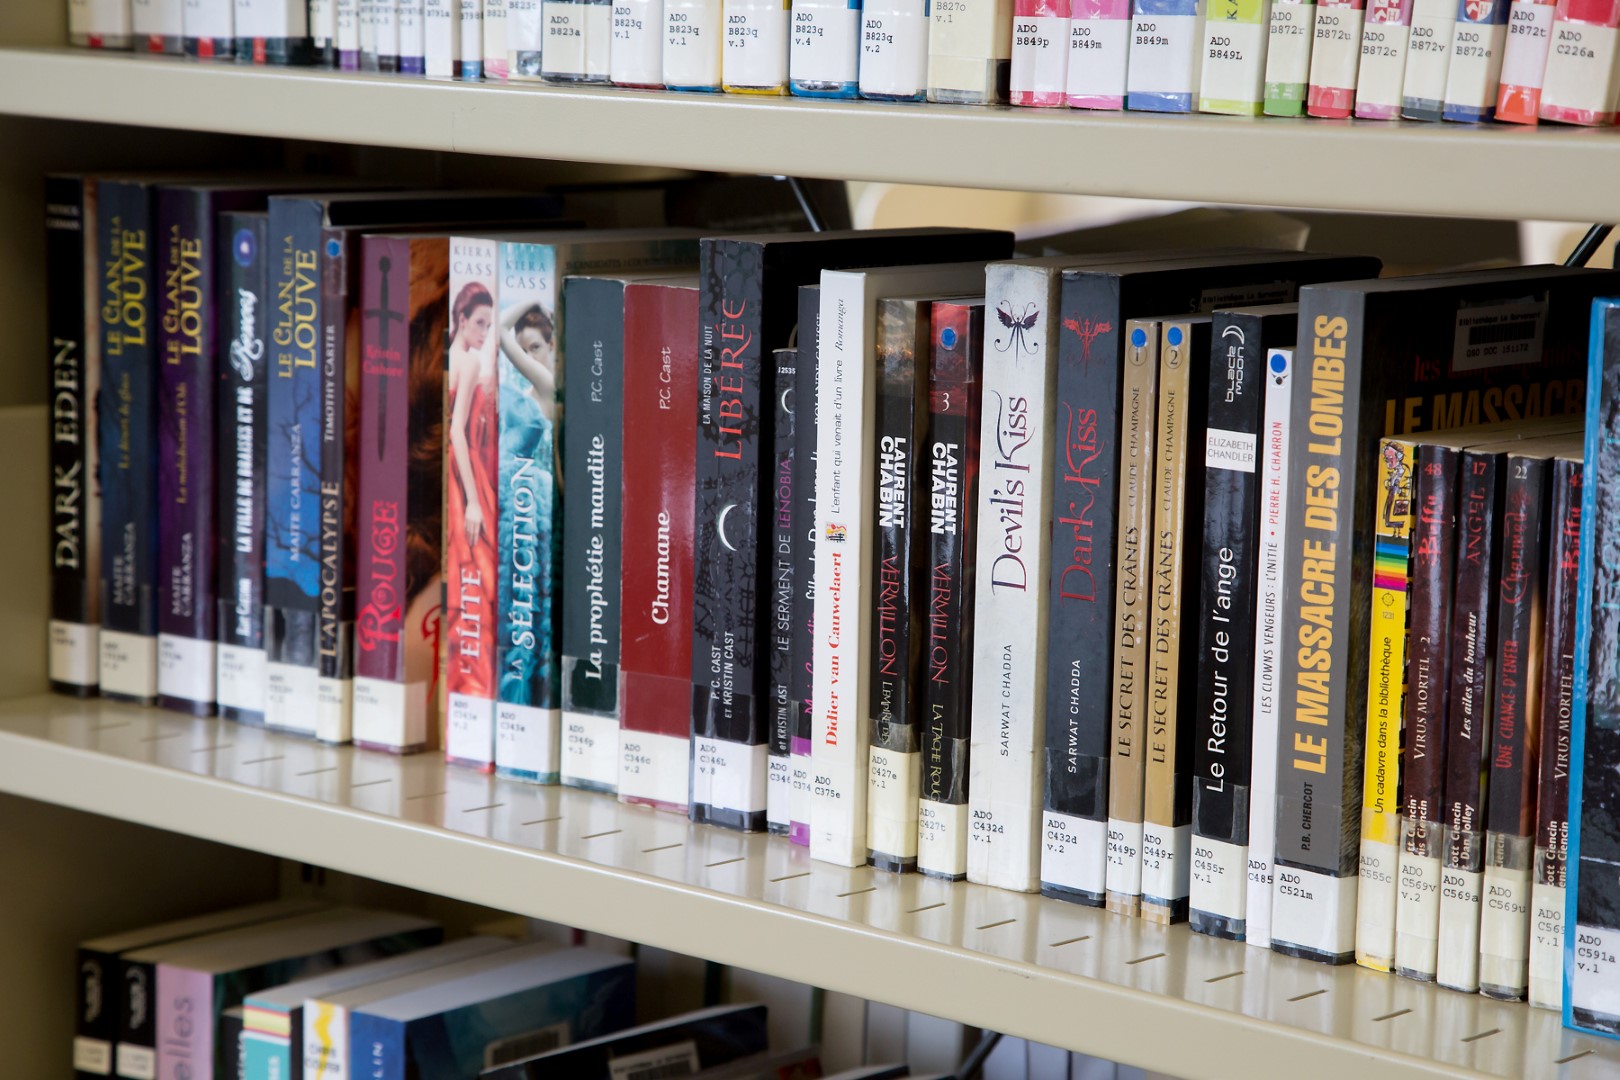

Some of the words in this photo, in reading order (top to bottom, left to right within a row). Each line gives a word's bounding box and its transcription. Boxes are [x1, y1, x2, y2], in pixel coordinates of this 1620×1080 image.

[551, 16, 569, 24] ADO
[796, 13, 813, 21] ADO
[866, 20, 882, 28] ADO
[1136, 24, 1156, 32] ADO
[1512, 11, 1535, 21] ADO
[550, 28, 580, 37] B823a
[669, 26, 700, 36] B823q
[669, 37, 686, 45] v.1
[796, 25, 823, 36] B823q
[866, 32, 893, 43] B823q
[1016, 25, 1038, 33] ADO
[1136, 36, 1169, 45] B849m
[1363, 33, 1385, 42] ADO
[1511, 25, 1547, 37] B872t
[1559, 31, 1582, 41] ADO
[796, 37, 811, 46] v.4
[865, 45, 880, 53] v.2
[1016, 37, 1050, 47] B849p
[1210, 37, 1231, 46] ADO
[1362, 46, 1397, 57] B872c
[1557, 45, 1595, 58] C226a
[1209, 50, 1243, 61] B849L
[452, 261, 492, 277] CASS
[122, 230, 146, 346] LOUVE
[504, 275, 546, 291] CASS
[180, 238, 202, 356] LOUVE
[294, 249, 317, 370] LOUVE
[323, 324, 335, 376] CARTER
[590, 340, 603, 377] Cast
[1169, 349, 1179, 366] 2
[659, 346, 671, 383] Cast
[833, 360, 843, 383] livre
[53, 337, 80, 445] EDEN
[714, 297, 752, 462] LIBÉRÉE
[1308, 314, 1348, 456] LOMBES
[590, 381, 603, 403] P.C.
[659, 387, 671, 410] P.C.
[834, 386, 843, 410] d'un
[323, 378, 336, 443] TIMOTHY
[1129, 386, 1141, 458] CHAMPAGNE
[834, 413, 843, 447] venait
[990, 390, 1036, 474] Kiss
[1164, 389, 1176, 462] CHAMPAGNE
[1061, 400, 1104, 489] Kiss
[1207, 448, 1254, 463] CHANDLER
[1208, 436, 1254, 452] ELIZABETH
[833, 450, 844, 468] qui
[1423, 461, 1442, 476] 48
[1472, 461, 1488, 476] 17
[588, 433, 604, 529] maudite
[878, 435, 895, 528] CHABIN
[894, 437, 907, 529] LAURENT
[1514, 464, 1528, 479] 22
[779, 458, 793, 529] LENOBIA
[830, 470, 843, 514] L'enfant
[930, 441, 947, 535] CHABIN
[946, 443, 960, 537] LAURENT
[1128, 463, 1137, 507] CLAUDE
[1163, 466, 1174, 512] CLAUDE
[1304, 465, 1341, 532] DES
[55, 459, 81, 569] DARK
[1466, 486, 1486, 566] ANGEL
[779, 534, 792, 555] DE
[989, 479, 1027, 597] Devil's
[1057, 488, 1097, 603] Dark
[508, 455, 536, 650] SÉLECTION
[1500, 511, 1532, 605] Charmed
[319, 480, 340, 660] L'APOCALYPSE
[357, 500, 402, 652] ROUGE
[651, 509, 670, 626] Chamane
[1121, 525, 1139, 607] CRÂNES
[1155, 530, 1174, 612] CRÂNES
[586, 533, 608, 646] prophétie
[778, 559, 791, 631] SERMENT
[1211, 547, 1237, 623] l'ange
[828, 553, 843, 651] Cauwelaert
[458, 567, 482, 675] L'ÉLITE
[879, 554, 902, 676] VERMILLON
[930, 563, 951, 685] VERMILLON
[778, 635, 790, 651] LE
[1120, 613, 1136, 649] DES
[1154, 616, 1170, 654] DES
[1295, 538, 1337, 727] MASSACRE
[1464, 611, 1478, 664] bonheur
[725, 631, 735, 660] CAST
[1211, 631, 1230, 663] de
[511, 657, 523, 680] LA
[585, 649, 603, 681] La
[830, 655, 841, 687] van
[1001, 644, 1012, 698] CHADDA
[1379, 636, 1393, 706] bibliothèque
[1502, 639, 1519, 688] D'ENFER
[723, 663, 735, 706] KRISTIN
[1069, 659, 1081, 714] CHADDA
[1463, 668, 1475, 685] du
[778, 684, 788, 705] CAST
[1118, 655, 1134, 731] SECRET
[1152, 660, 1168, 736] SECRET
[1462, 686, 1473, 716] ailes
[724, 709, 732, 719] ET
[778, 707, 788, 739] KRISTIN
[826, 691, 839, 747] Didier
[932, 703, 944, 720] LA
[1207, 670, 1229, 754] Retour
[1379, 707, 1388, 719] la
[1499, 695, 1517, 740] CHANCE
[1000, 703, 1010, 757] SARWAT
[1378, 721, 1388, 749] dans
[1460, 718, 1472, 741] Les
[780, 740, 788, 752] et
[931, 722, 943, 763] TACHE
[1067, 718, 1079, 774] SARWAT
[1117, 736, 1131, 758] LE
[1152, 742, 1166, 764] LE
[1292, 732, 1328, 775] LE
[1495, 744, 1513, 769] UNE
[815, 776, 832, 785] ADO
[930, 765, 942, 801] ROUG
[1205, 762, 1225, 793] Le
[1376, 750, 1387, 796] cadavre
[815, 788, 841, 798] C375e
[974, 810, 993, 821] ADO
[1301, 781, 1313, 830] CHERCOT
[1375, 797, 1385, 814] Un
[974, 822, 1004, 835] C432d
[1047, 819, 1067, 831] ADO
[973, 834, 992, 844] v.1
[1047, 831, 1078, 845] C432d
[1047, 843, 1066, 854] v.2
[1301, 832, 1312, 852] P.B.
[1547, 820, 1558, 861] Ciencin
[1194, 848, 1213, 859] ADO
[1361, 856, 1380, 868] ADO
[1194, 860, 1226, 875] C455r
[1194, 873, 1212, 884] v.1
[1281, 873, 1301, 885] ADO
[1361, 868, 1393, 884] C555c
[1401, 865, 1422, 877] ADO
[1280, 885, 1314, 901] C521m
[1401, 877, 1437, 892] C569v
[1443, 875, 1465, 888] ADO
[1489, 887, 1512, 899] ADO
[1401, 891, 1420, 903] v.2
[1443, 888, 1479, 903] C569a
[1489, 899, 1526, 914] C569u
[1577, 934, 1600, 948] ADO
[1577, 948, 1616, 964] C591a
[1577, 962, 1599, 975] v.1
